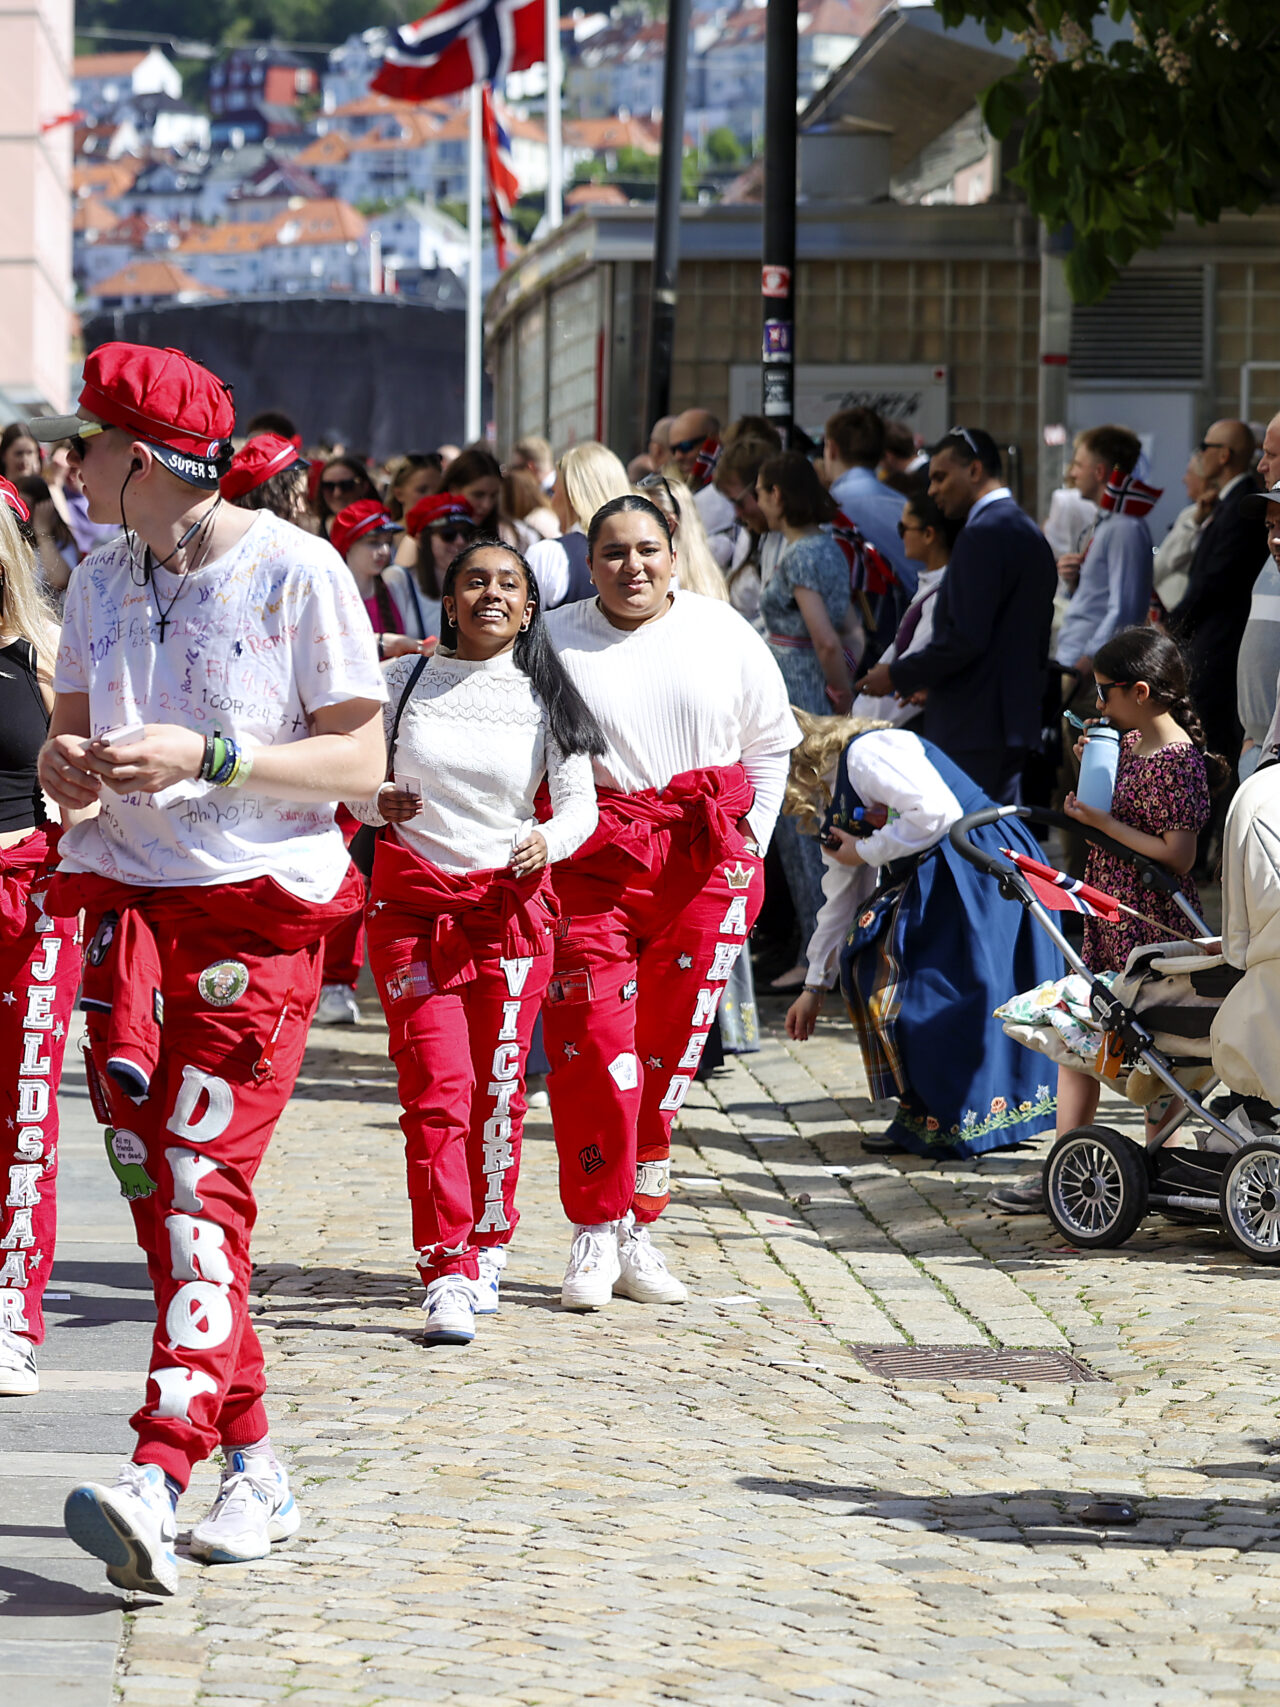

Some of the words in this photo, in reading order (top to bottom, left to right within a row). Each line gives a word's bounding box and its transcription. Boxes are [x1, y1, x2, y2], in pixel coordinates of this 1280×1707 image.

[168, 454, 205, 478] SUPER
[659, 895, 748, 1111] AHMED
[473, 956, 533, 1233] VICTORIA
[579, 1144, 600, 1170] 100
